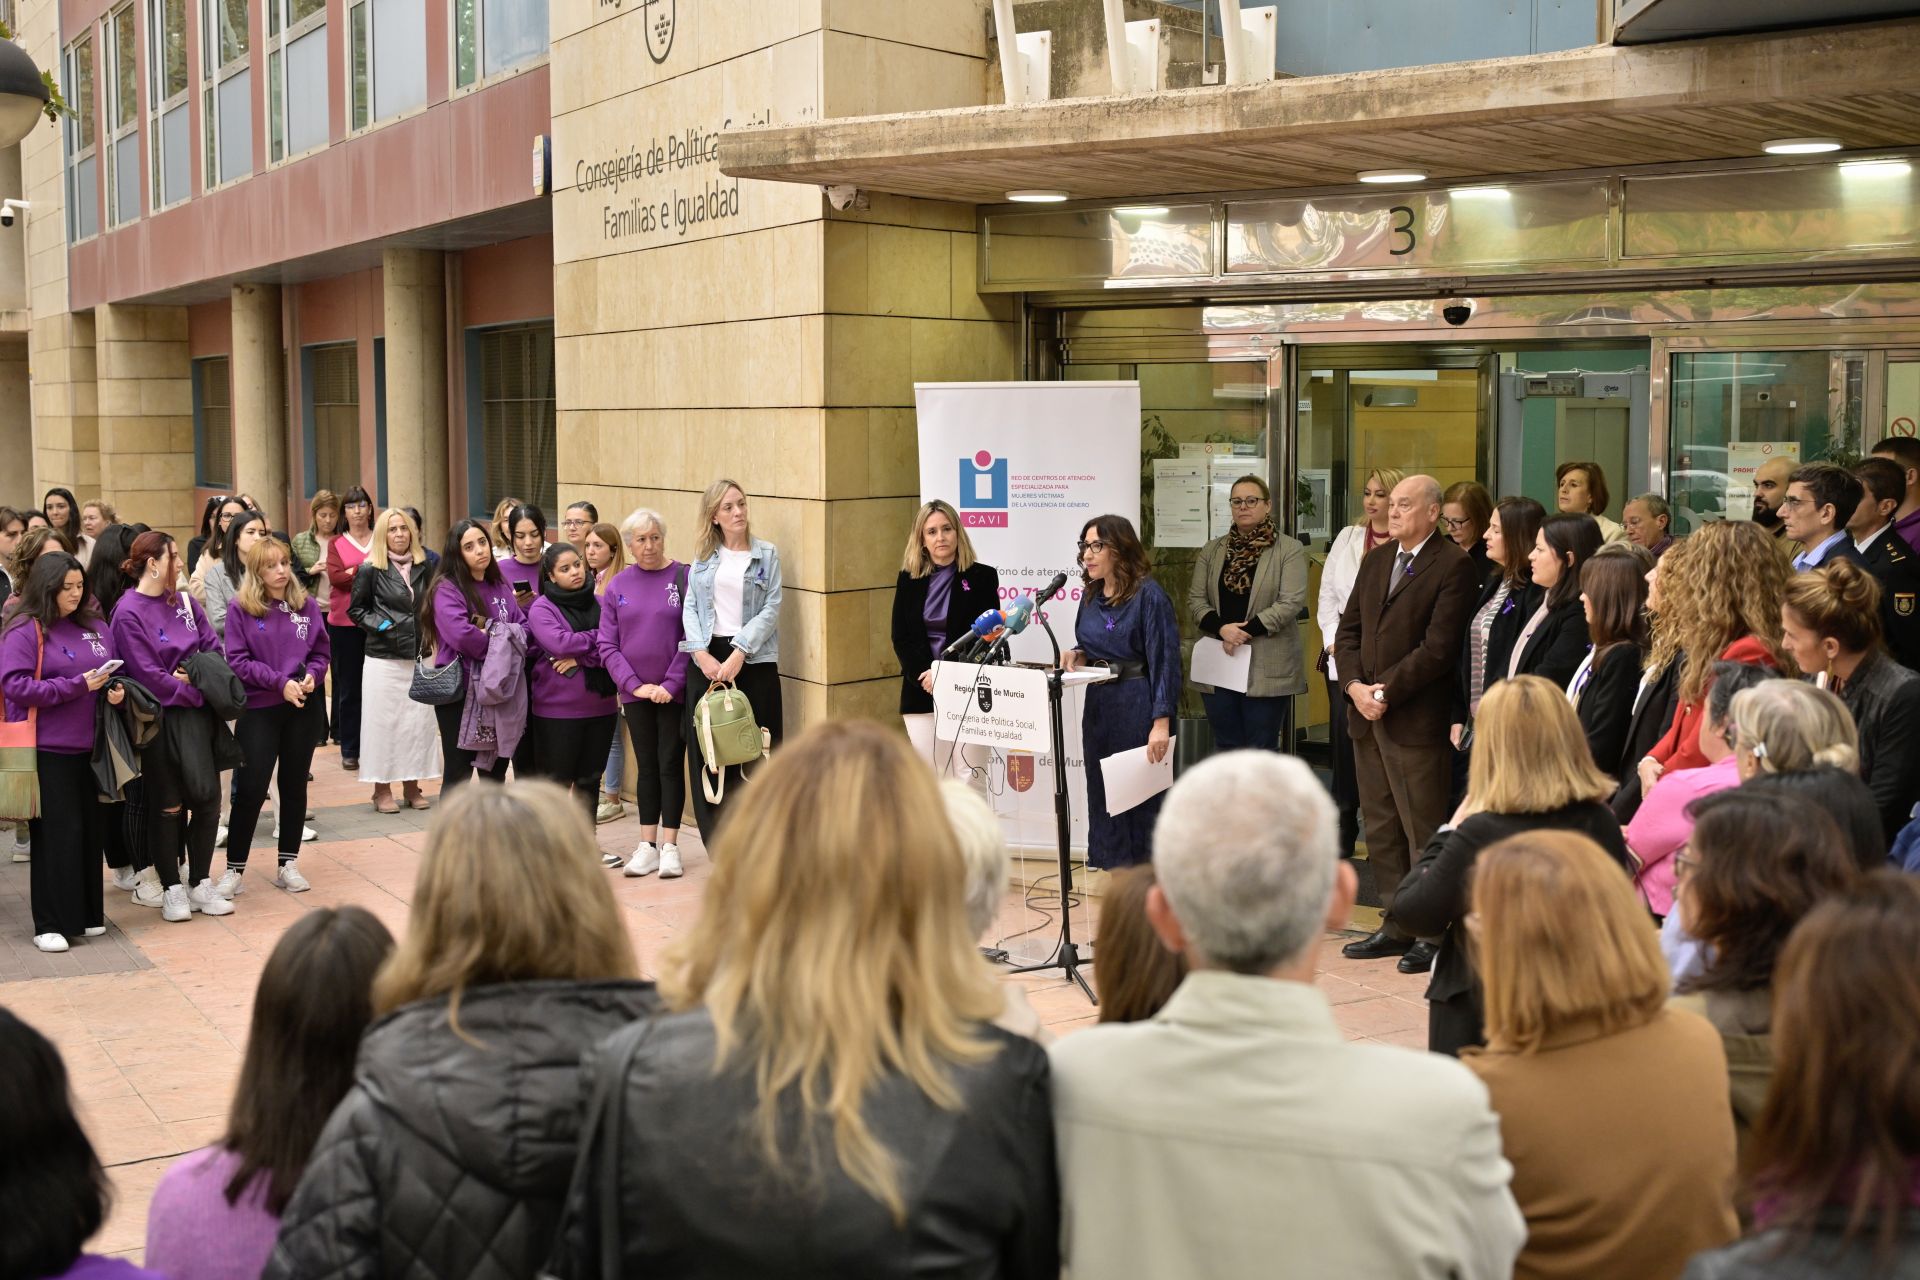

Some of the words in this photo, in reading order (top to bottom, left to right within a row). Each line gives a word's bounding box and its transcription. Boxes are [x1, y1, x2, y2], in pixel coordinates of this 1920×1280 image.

[576, 144, 643, 194] Consejería
[646, 138, 664, 176] de
[669, 126, 719, 172] Política
[604, 197, 656, 240] Familias
[660, 201, 669, 229] e
[674, 177, 739, 236] Igualdad
[1389, 206, 1416, 256] 3
[968, 515, 1001, 525] CAVI
[995, 566, 1018, 576] fono
[1020, 567, 1034, 576] de
[1037, 567, 1081, 577] atención
[998, 587, 1018, 600] 00
[954, 684, 976, 694] Región
[993, 688, 1002, 696] de
[1003, 689, 1025, 698] Murcia
[981, 716, 990, 724] de
[991, 716, 1014, 727] Política
[1015, 719, 1037, 731] Social,
[961, 725, 987, 737] Familias
[993, 730, 1023, 741] Igualdad
[1038, 755, 1053, 767] de
